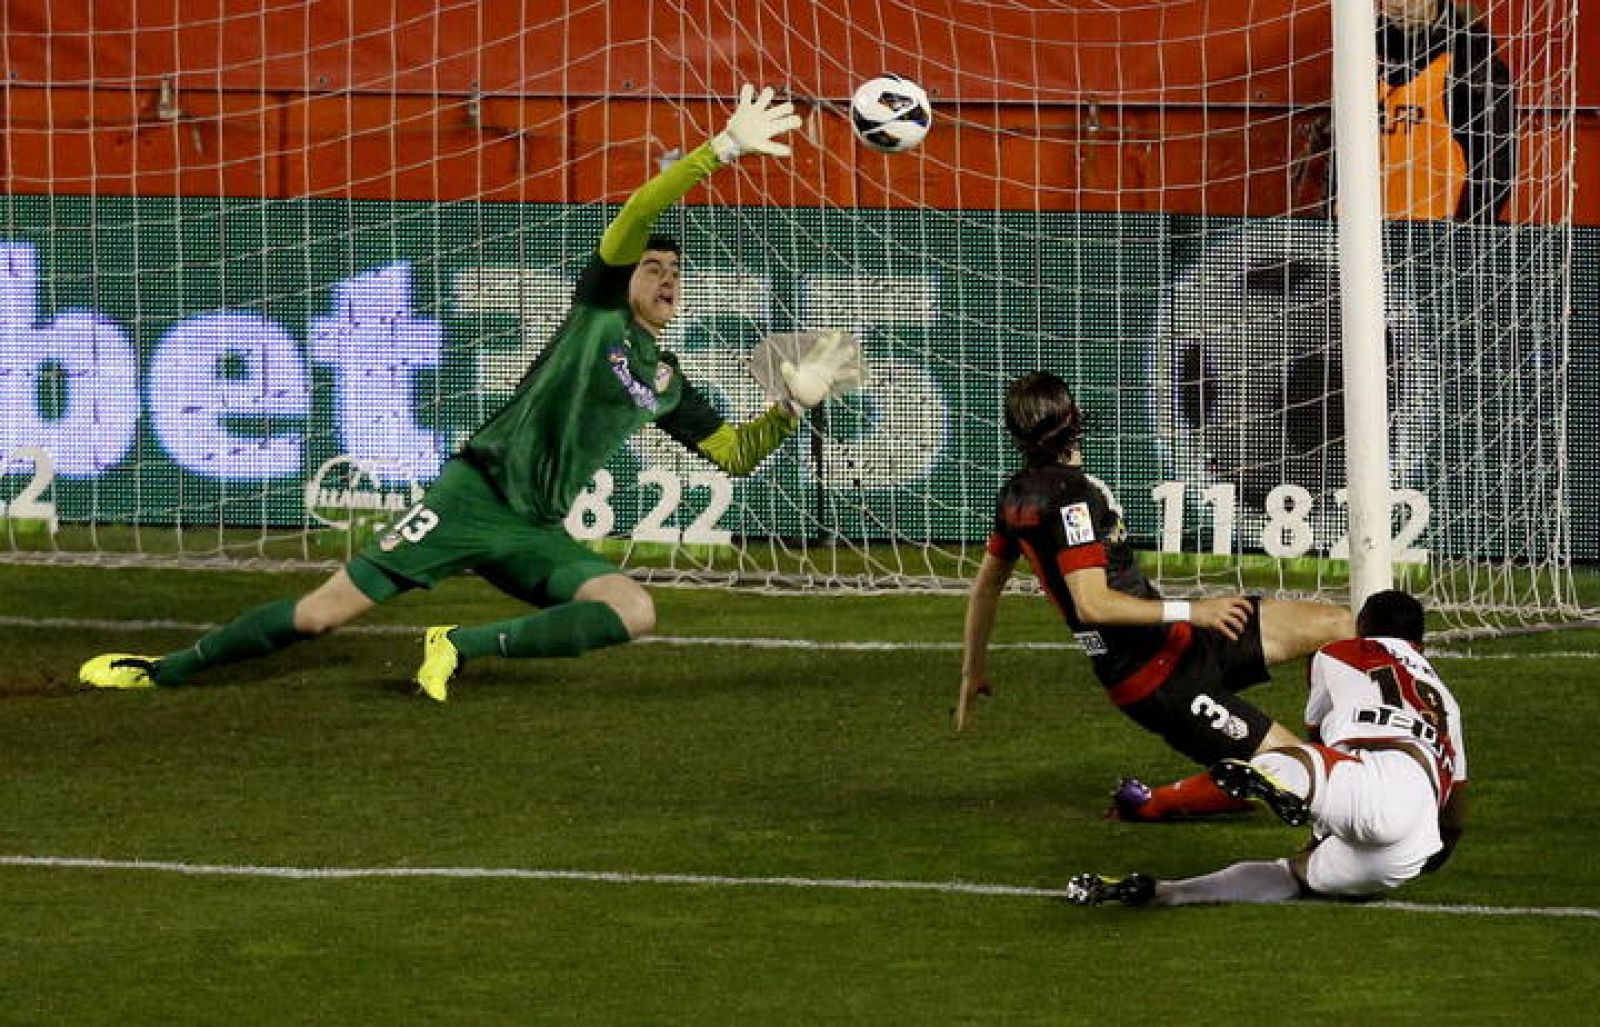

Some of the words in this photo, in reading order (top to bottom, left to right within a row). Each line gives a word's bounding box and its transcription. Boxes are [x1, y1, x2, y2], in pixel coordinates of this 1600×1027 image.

[0, 446, 57, 518] 2
[394, 504, 439, 543] 13
[1190, 693, 1230, 729] 3
